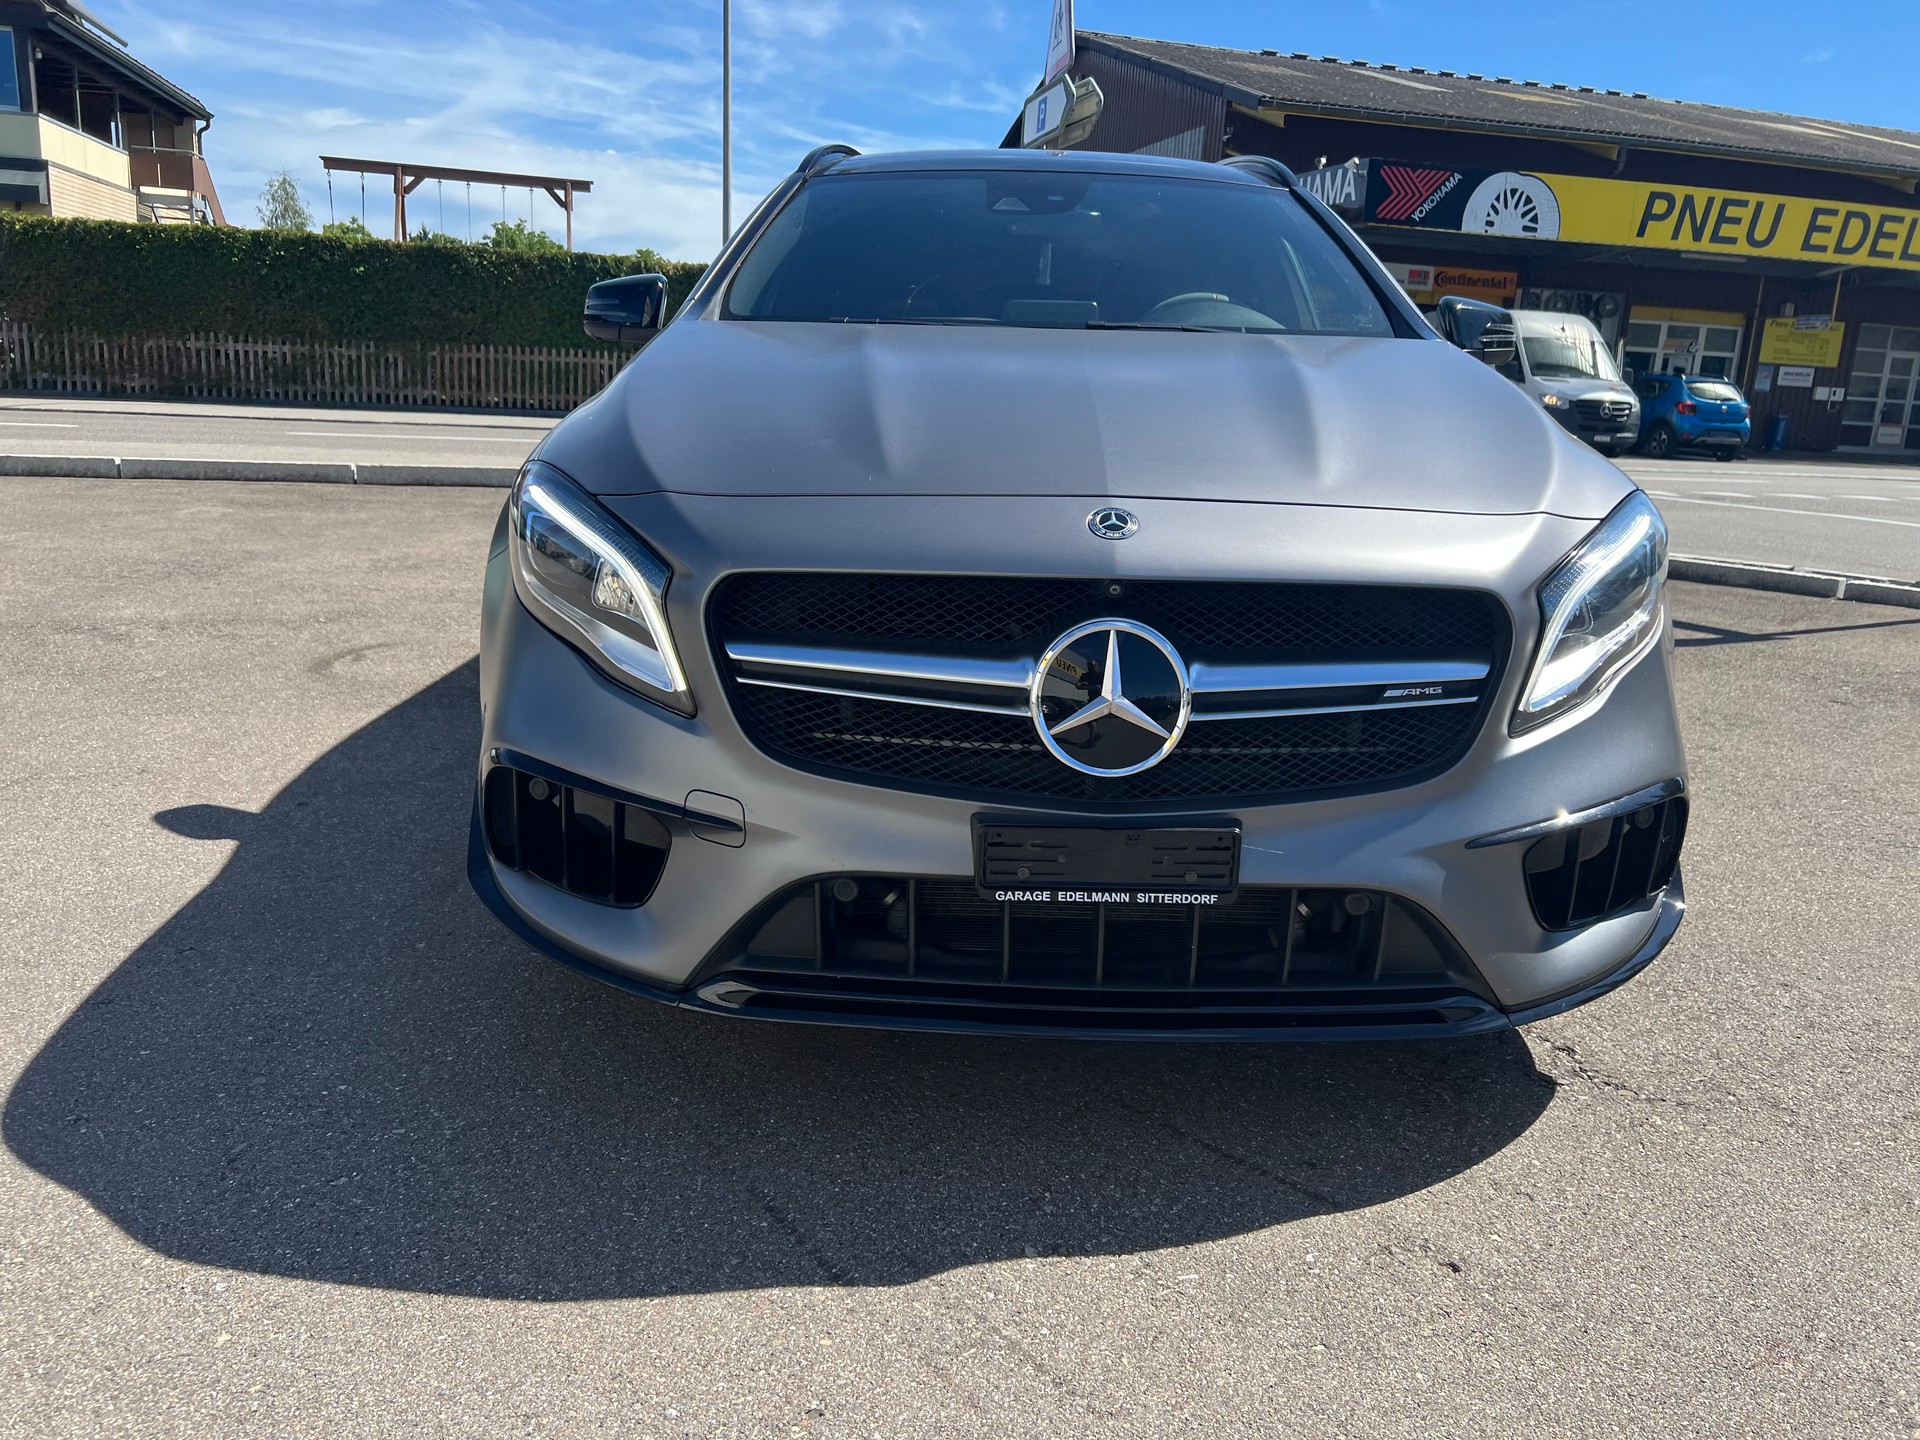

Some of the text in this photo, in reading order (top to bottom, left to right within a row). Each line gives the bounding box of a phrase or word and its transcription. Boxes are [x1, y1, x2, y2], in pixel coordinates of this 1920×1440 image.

[1411, 172, 1463, 222] YOKOHAMA
[1636, 191, 1920, 262] PNEU EDEL
[1434, 271, 1507, 289] Continental
[1402, 687, 1442, 696] AMG
[995, 891, 1219, 905] GARAGE EDELMANN SITTERDORF
